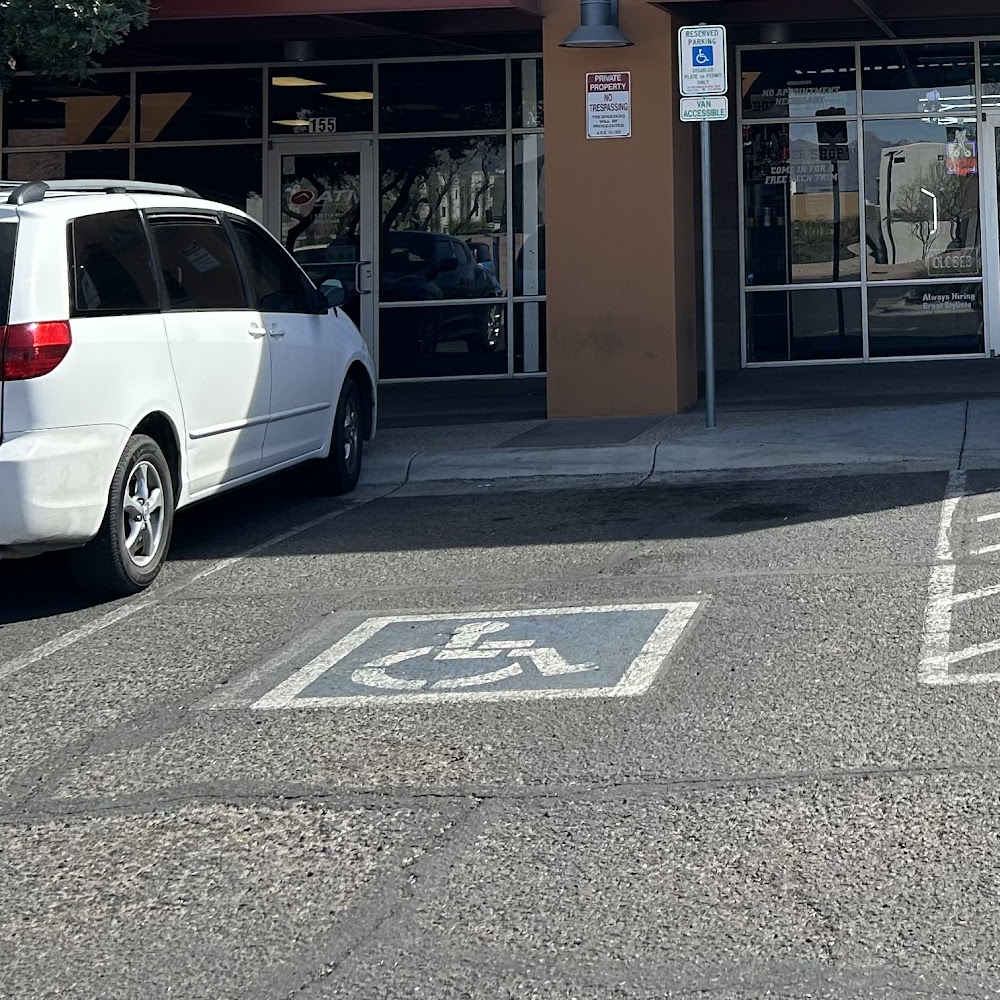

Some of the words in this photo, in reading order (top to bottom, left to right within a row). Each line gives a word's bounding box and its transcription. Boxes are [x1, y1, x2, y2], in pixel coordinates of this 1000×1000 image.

[685, 29, 719, 38] RESERVED
[688, 38, 717, 46] PARKING
[594, 74, 622, 83] PRIVATE
[589, 82, 627, 92] PROPERTY
[603, 93, 613, 102] NO
[761, 89, 775, 98] NO
[589, 102, 629, 112] TRESPASSING
[683, 109, 725, 118] ACCESSIBLE
[310, 118, 335, 132] 155
[808, 165, 829, 173] FOR
[764, 175, 788, 185] FREE
[315, 189, 355, 203] ATI
[932, 255, 973, 269] CLOSED
[922, 293, 950, 302] Always
[951, 292, 976, 301] Hiring
